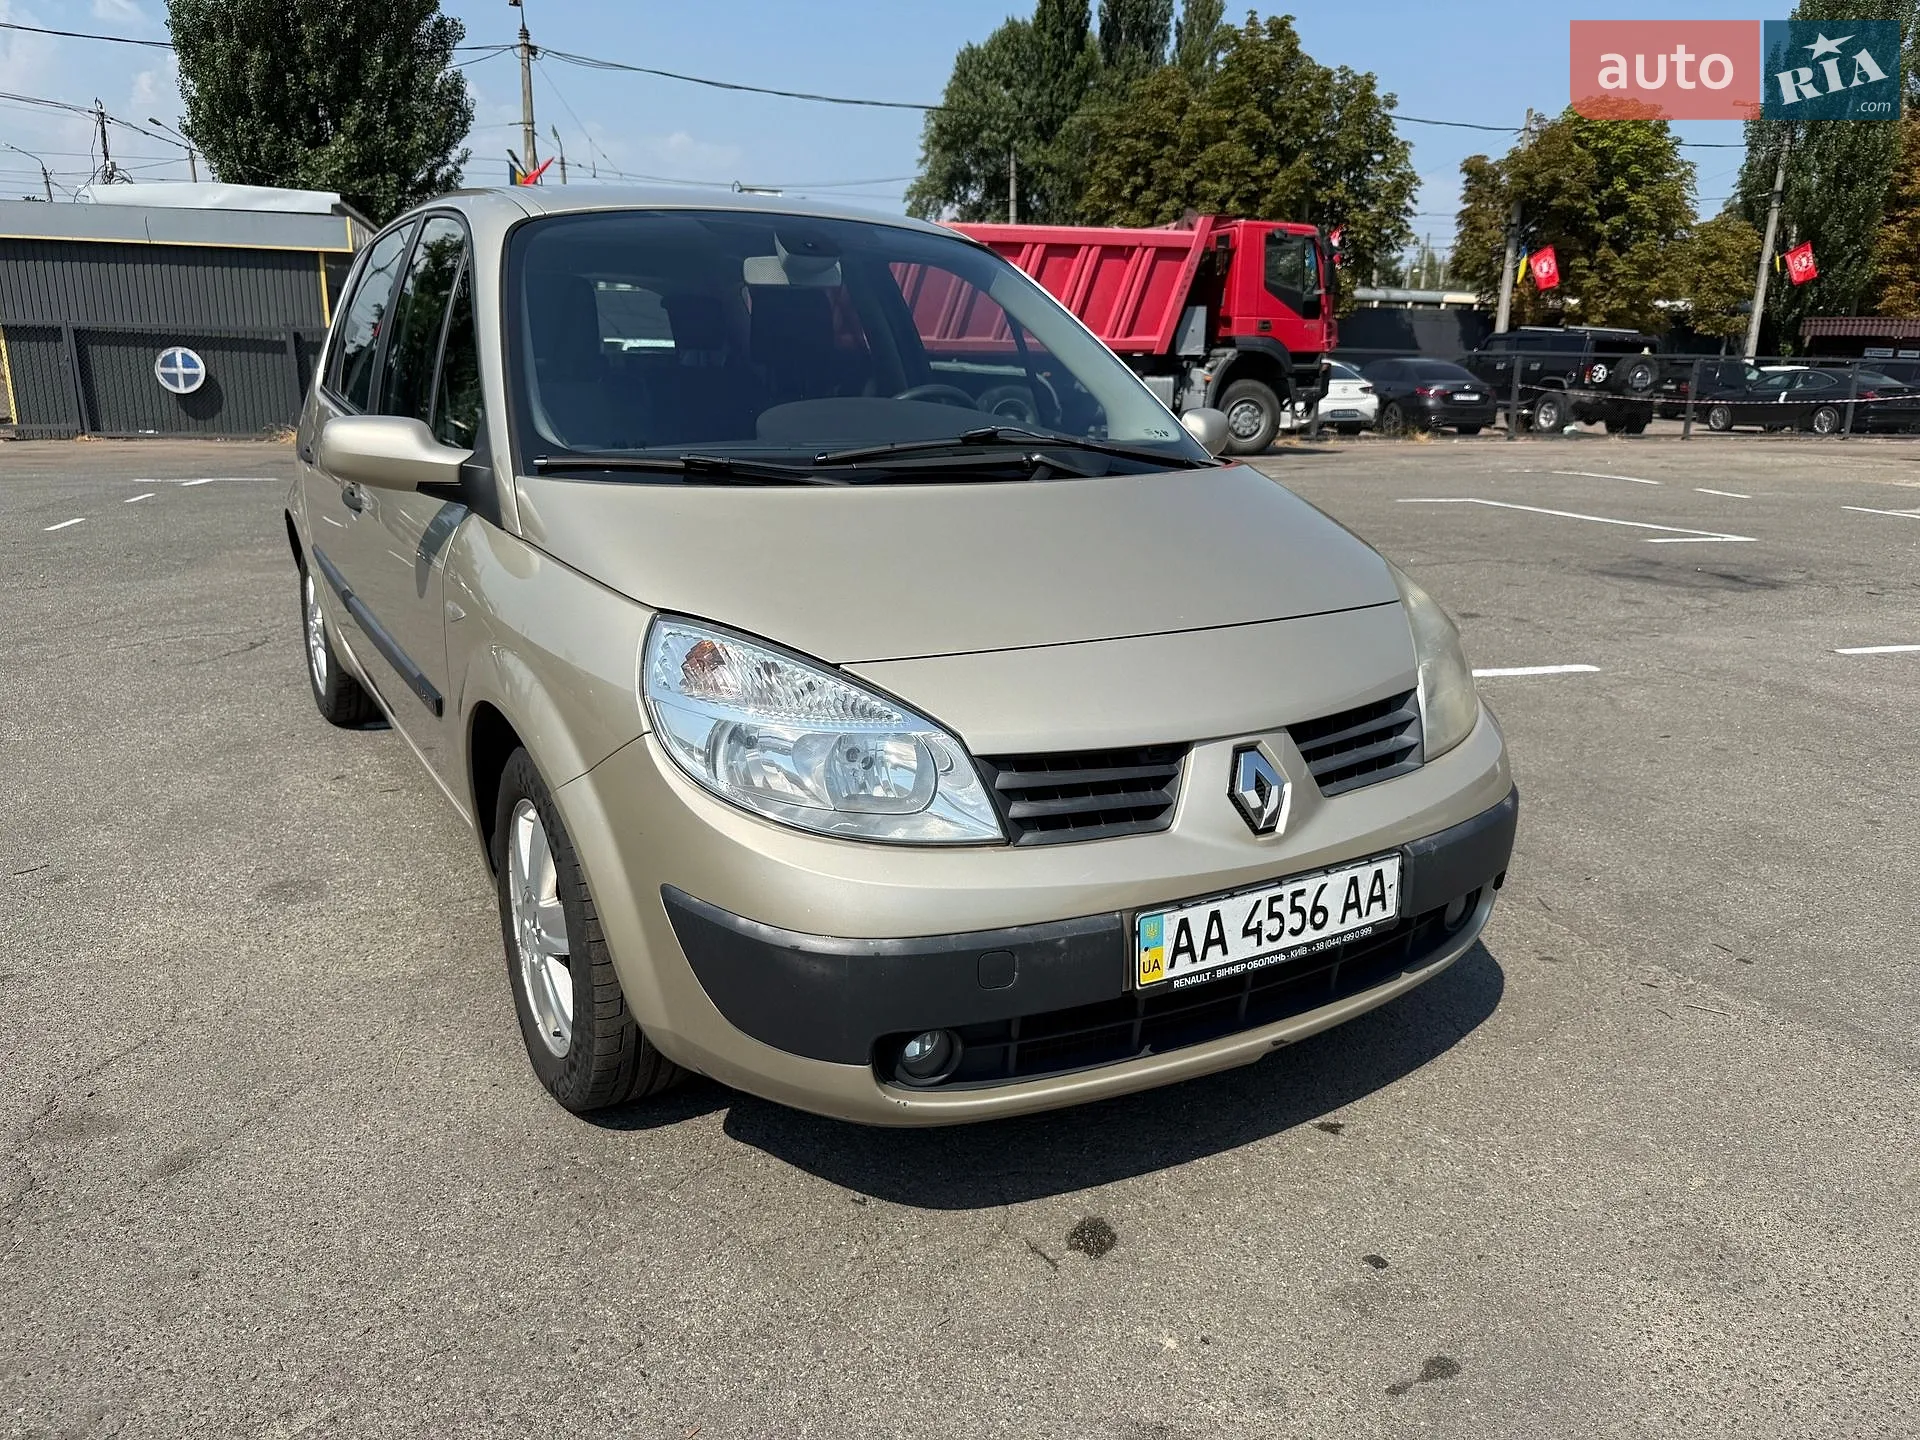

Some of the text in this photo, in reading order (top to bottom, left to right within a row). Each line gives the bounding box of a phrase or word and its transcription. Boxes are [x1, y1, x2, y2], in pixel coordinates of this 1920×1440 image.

[1168, 868, 1388, 969] AA 4556 AA
[1142, 958, 1161, 974] UA
[1173, 971, 1211, 989] RENAULT
[1216, 963, 1246, 979] ВІННЕР
[1247, 952, 1286, 970] ОБОЛОНЬ
[1290, 945, 1308, 958] КИЇВ
[1312, 942, 1325, 952] +38
[1325, 936, 1342, 949] (044)
[1342, 932, 1355, 943] 499
[1360, 926, 1373, 936] 999
